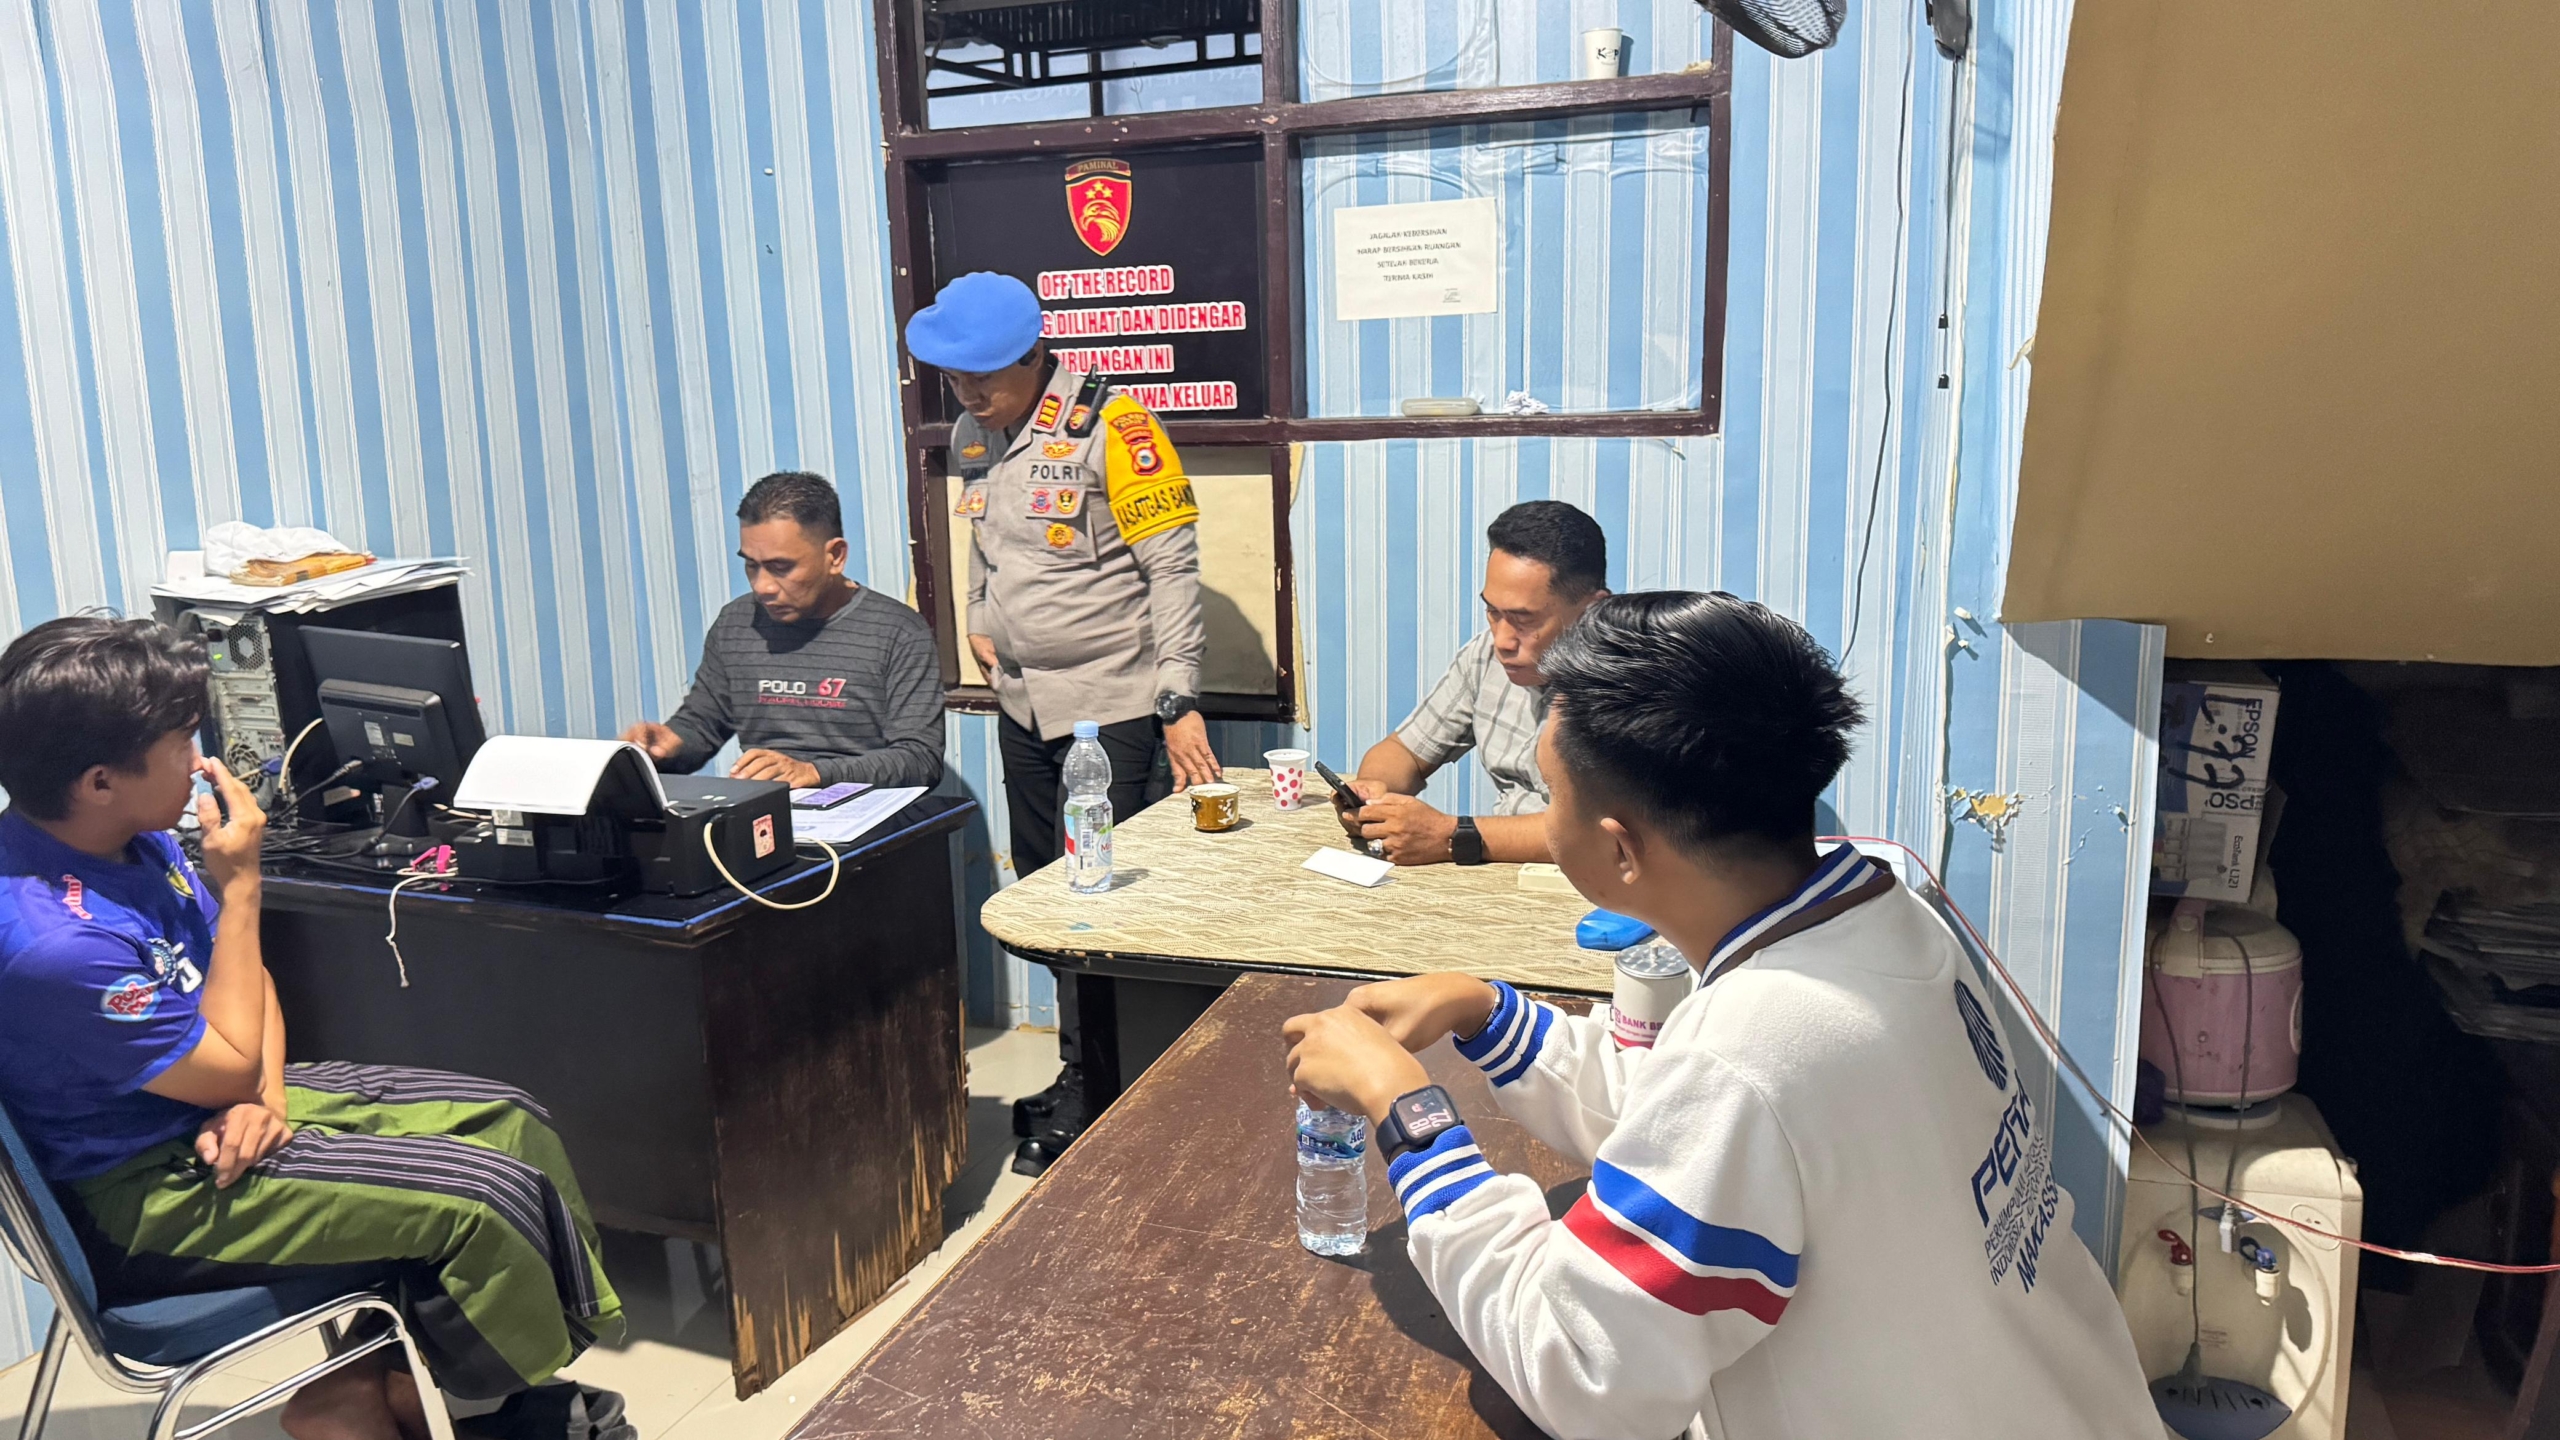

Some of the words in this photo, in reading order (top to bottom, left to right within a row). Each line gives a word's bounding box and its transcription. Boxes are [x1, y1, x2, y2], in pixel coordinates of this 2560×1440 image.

[1077, 161, 1119, 172] PAMINAL
[1403, 228, 1447, 237] KEBERSIHAN
[1357, 247, 1381, 255] HARAP
[1383, 244, 1422, 253] BERSIHKAN
[1424, 241, 1461, 250] RUANGAN
[1377, 260, 1407, 269] SETELAH
[1409, 258, 1439, 267] BEKERJA
[1040, 273, 1068, 298] OFF
[1070, 271, 1102, 296] THE
[1104, 267, 1171, 295] RECORD
[1383, 274, 1410, 282] TERIMA
[1412, 272, 1434, 281] KASIH
[1056, 310, 1120, 336] DILIHAT
[1122, 307, 1155, 333] DAN
[1158, 303, 1244, 331] DIDENGAR
[1147, 346, 1172, 370] INI
[1172, 383, 1236, 408] KELUAR
[1030, 464, 1080, 480] POLRI
[758, 679, 806, 695] POLO
[817, 677, 847, 698] 67
[2242, 698, 2263, 759] EPSON
[1622, 1014, 1647, 1030] BANK
